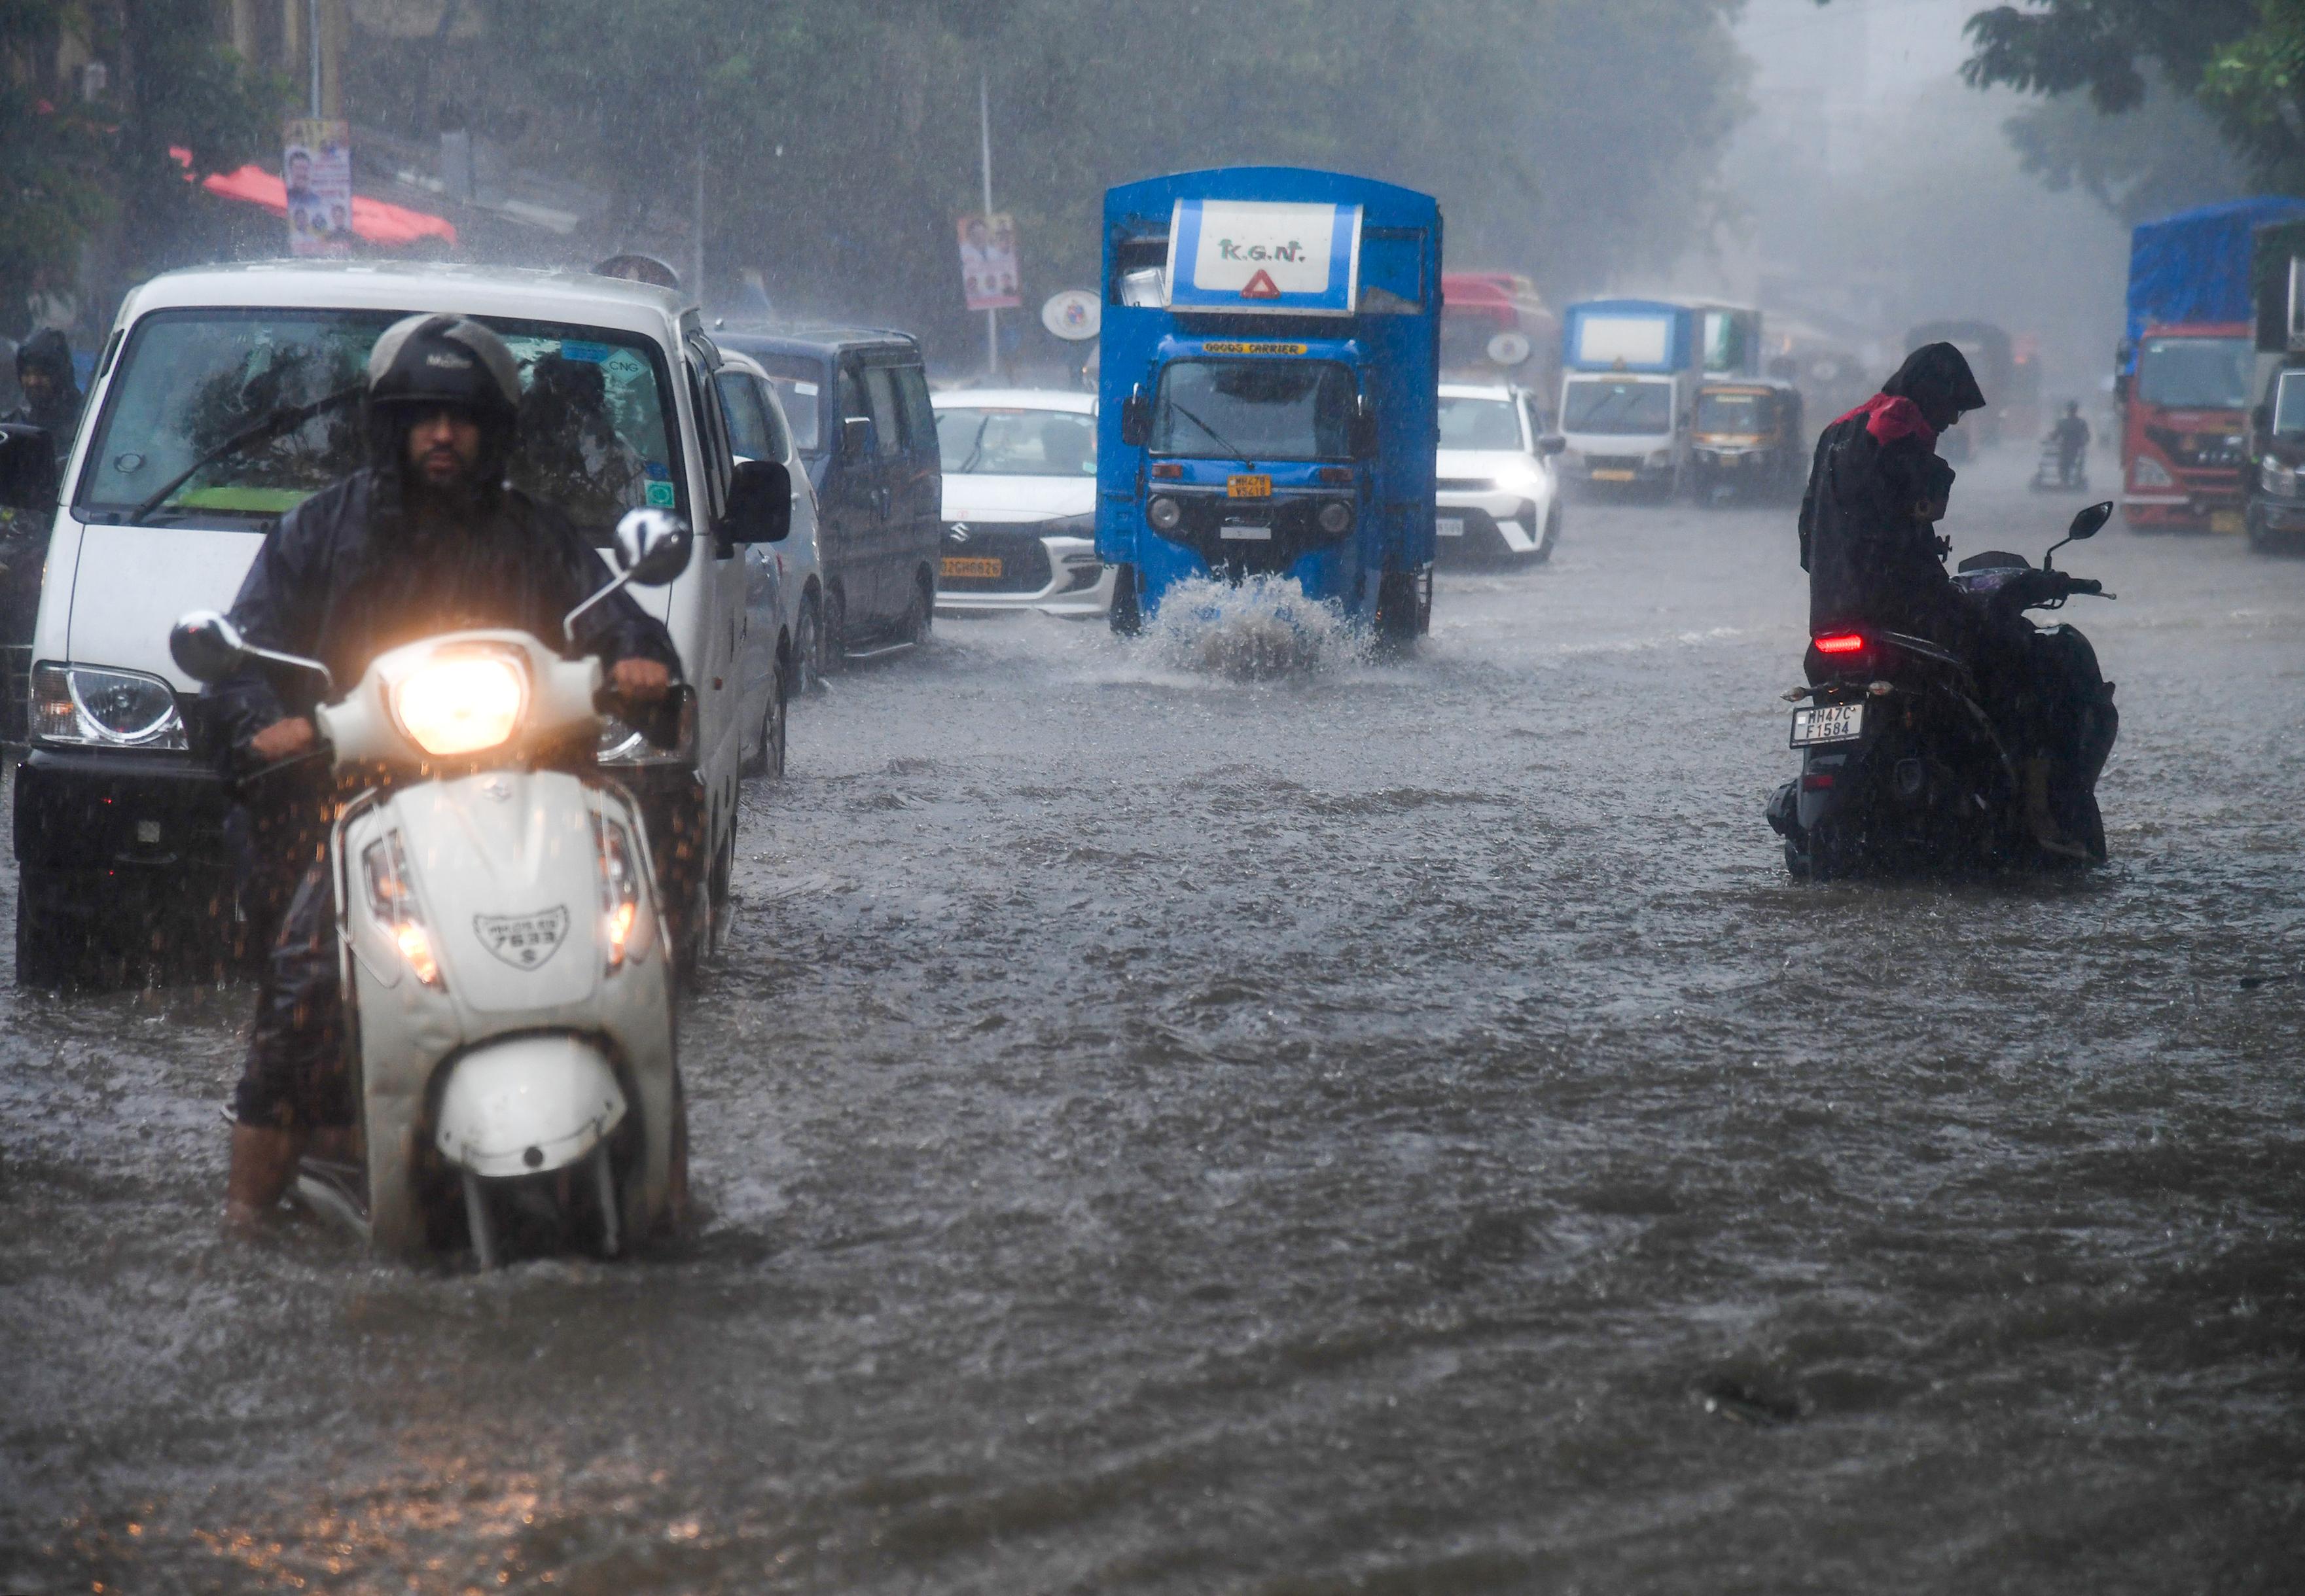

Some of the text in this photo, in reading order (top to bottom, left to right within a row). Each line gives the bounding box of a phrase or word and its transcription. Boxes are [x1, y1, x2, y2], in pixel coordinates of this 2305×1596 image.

[1219, 239, 1306, 262] K.G.N.
[1205, 343, 1299, 354] GOODS CARRIER
[609, 361, 639, 372] CNG
[1808, 707, 1851, 724] MH47C
[1806, 721, 1849, 738] F1584
